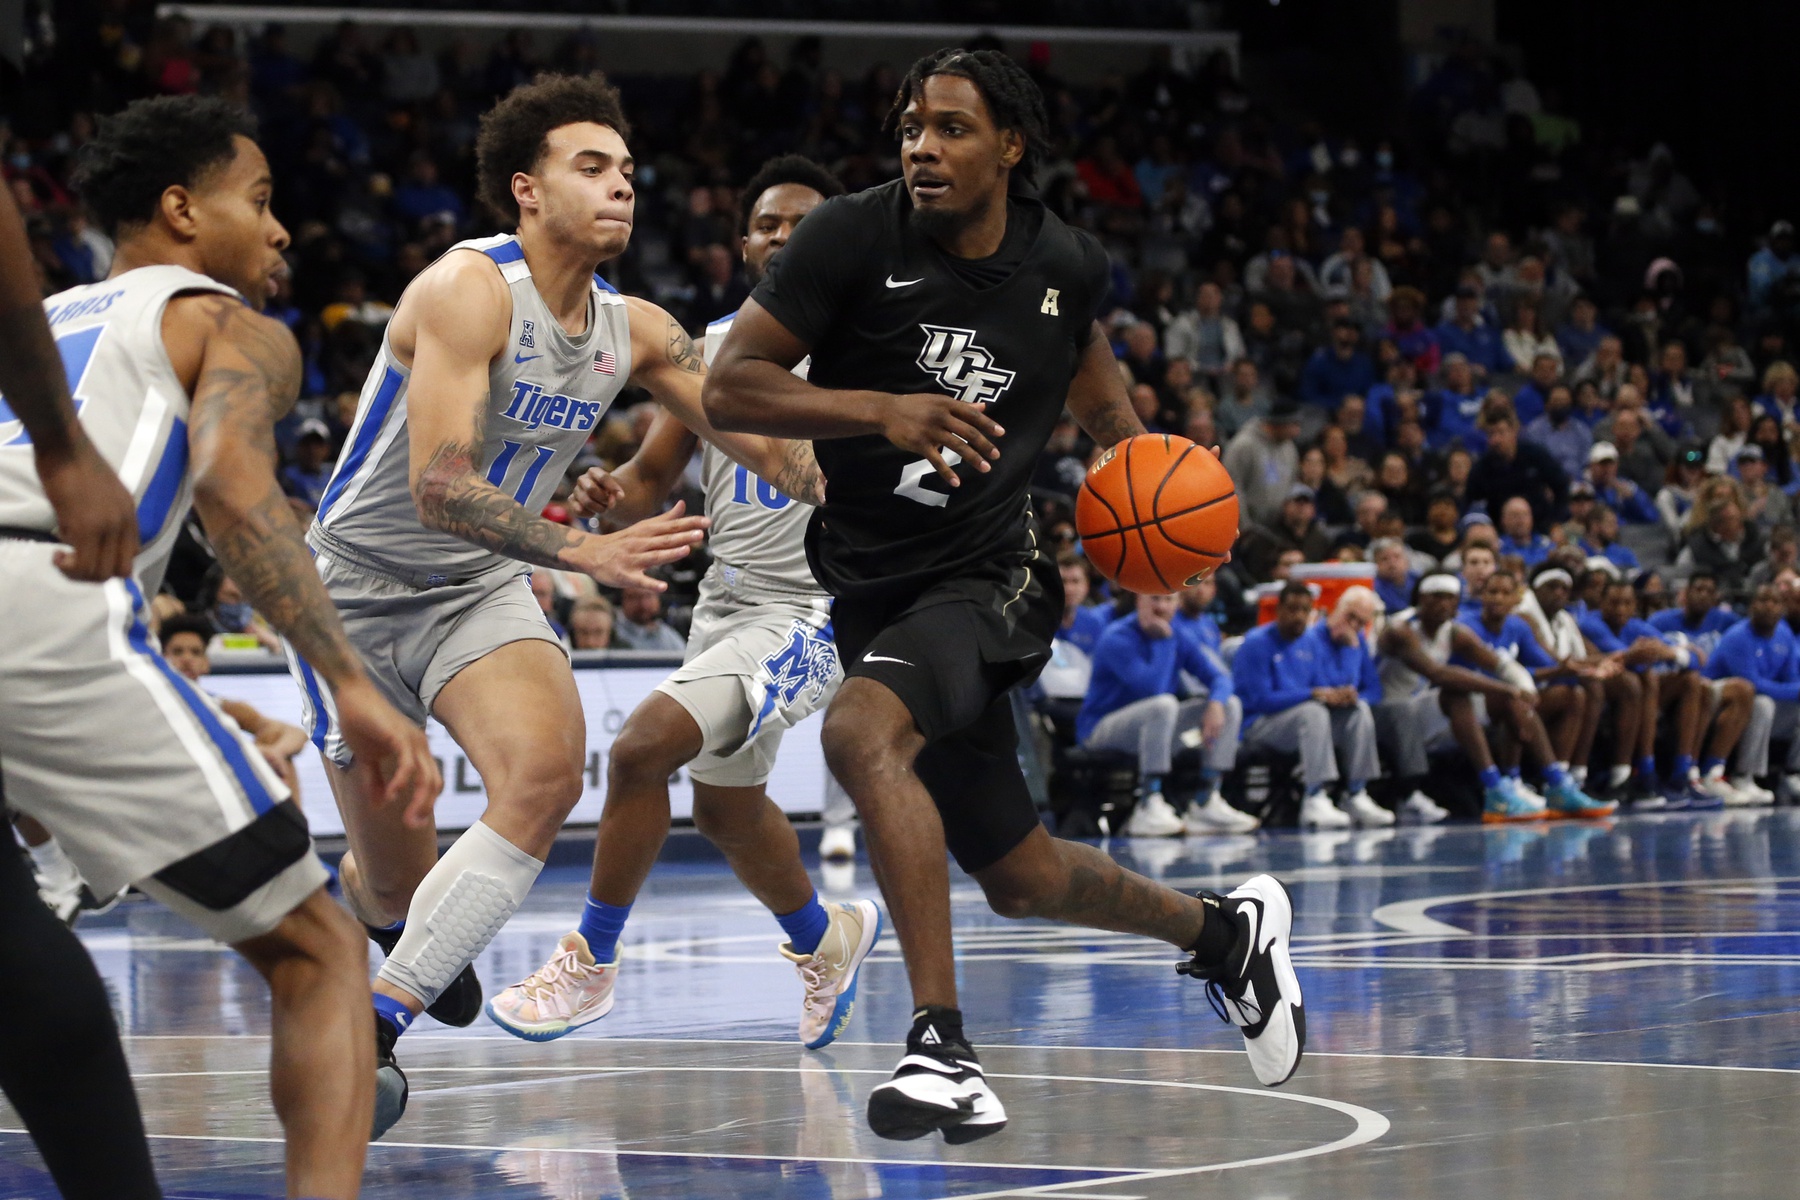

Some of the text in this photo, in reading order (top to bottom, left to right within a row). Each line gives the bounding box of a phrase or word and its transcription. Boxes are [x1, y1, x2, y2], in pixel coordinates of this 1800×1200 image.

[46, 288, 125, 327] ARRIS
[916, 323, 1016, 404] UCF
[499, 379, 602, 431] Tigers
[486, 439, 557, 508] 11
